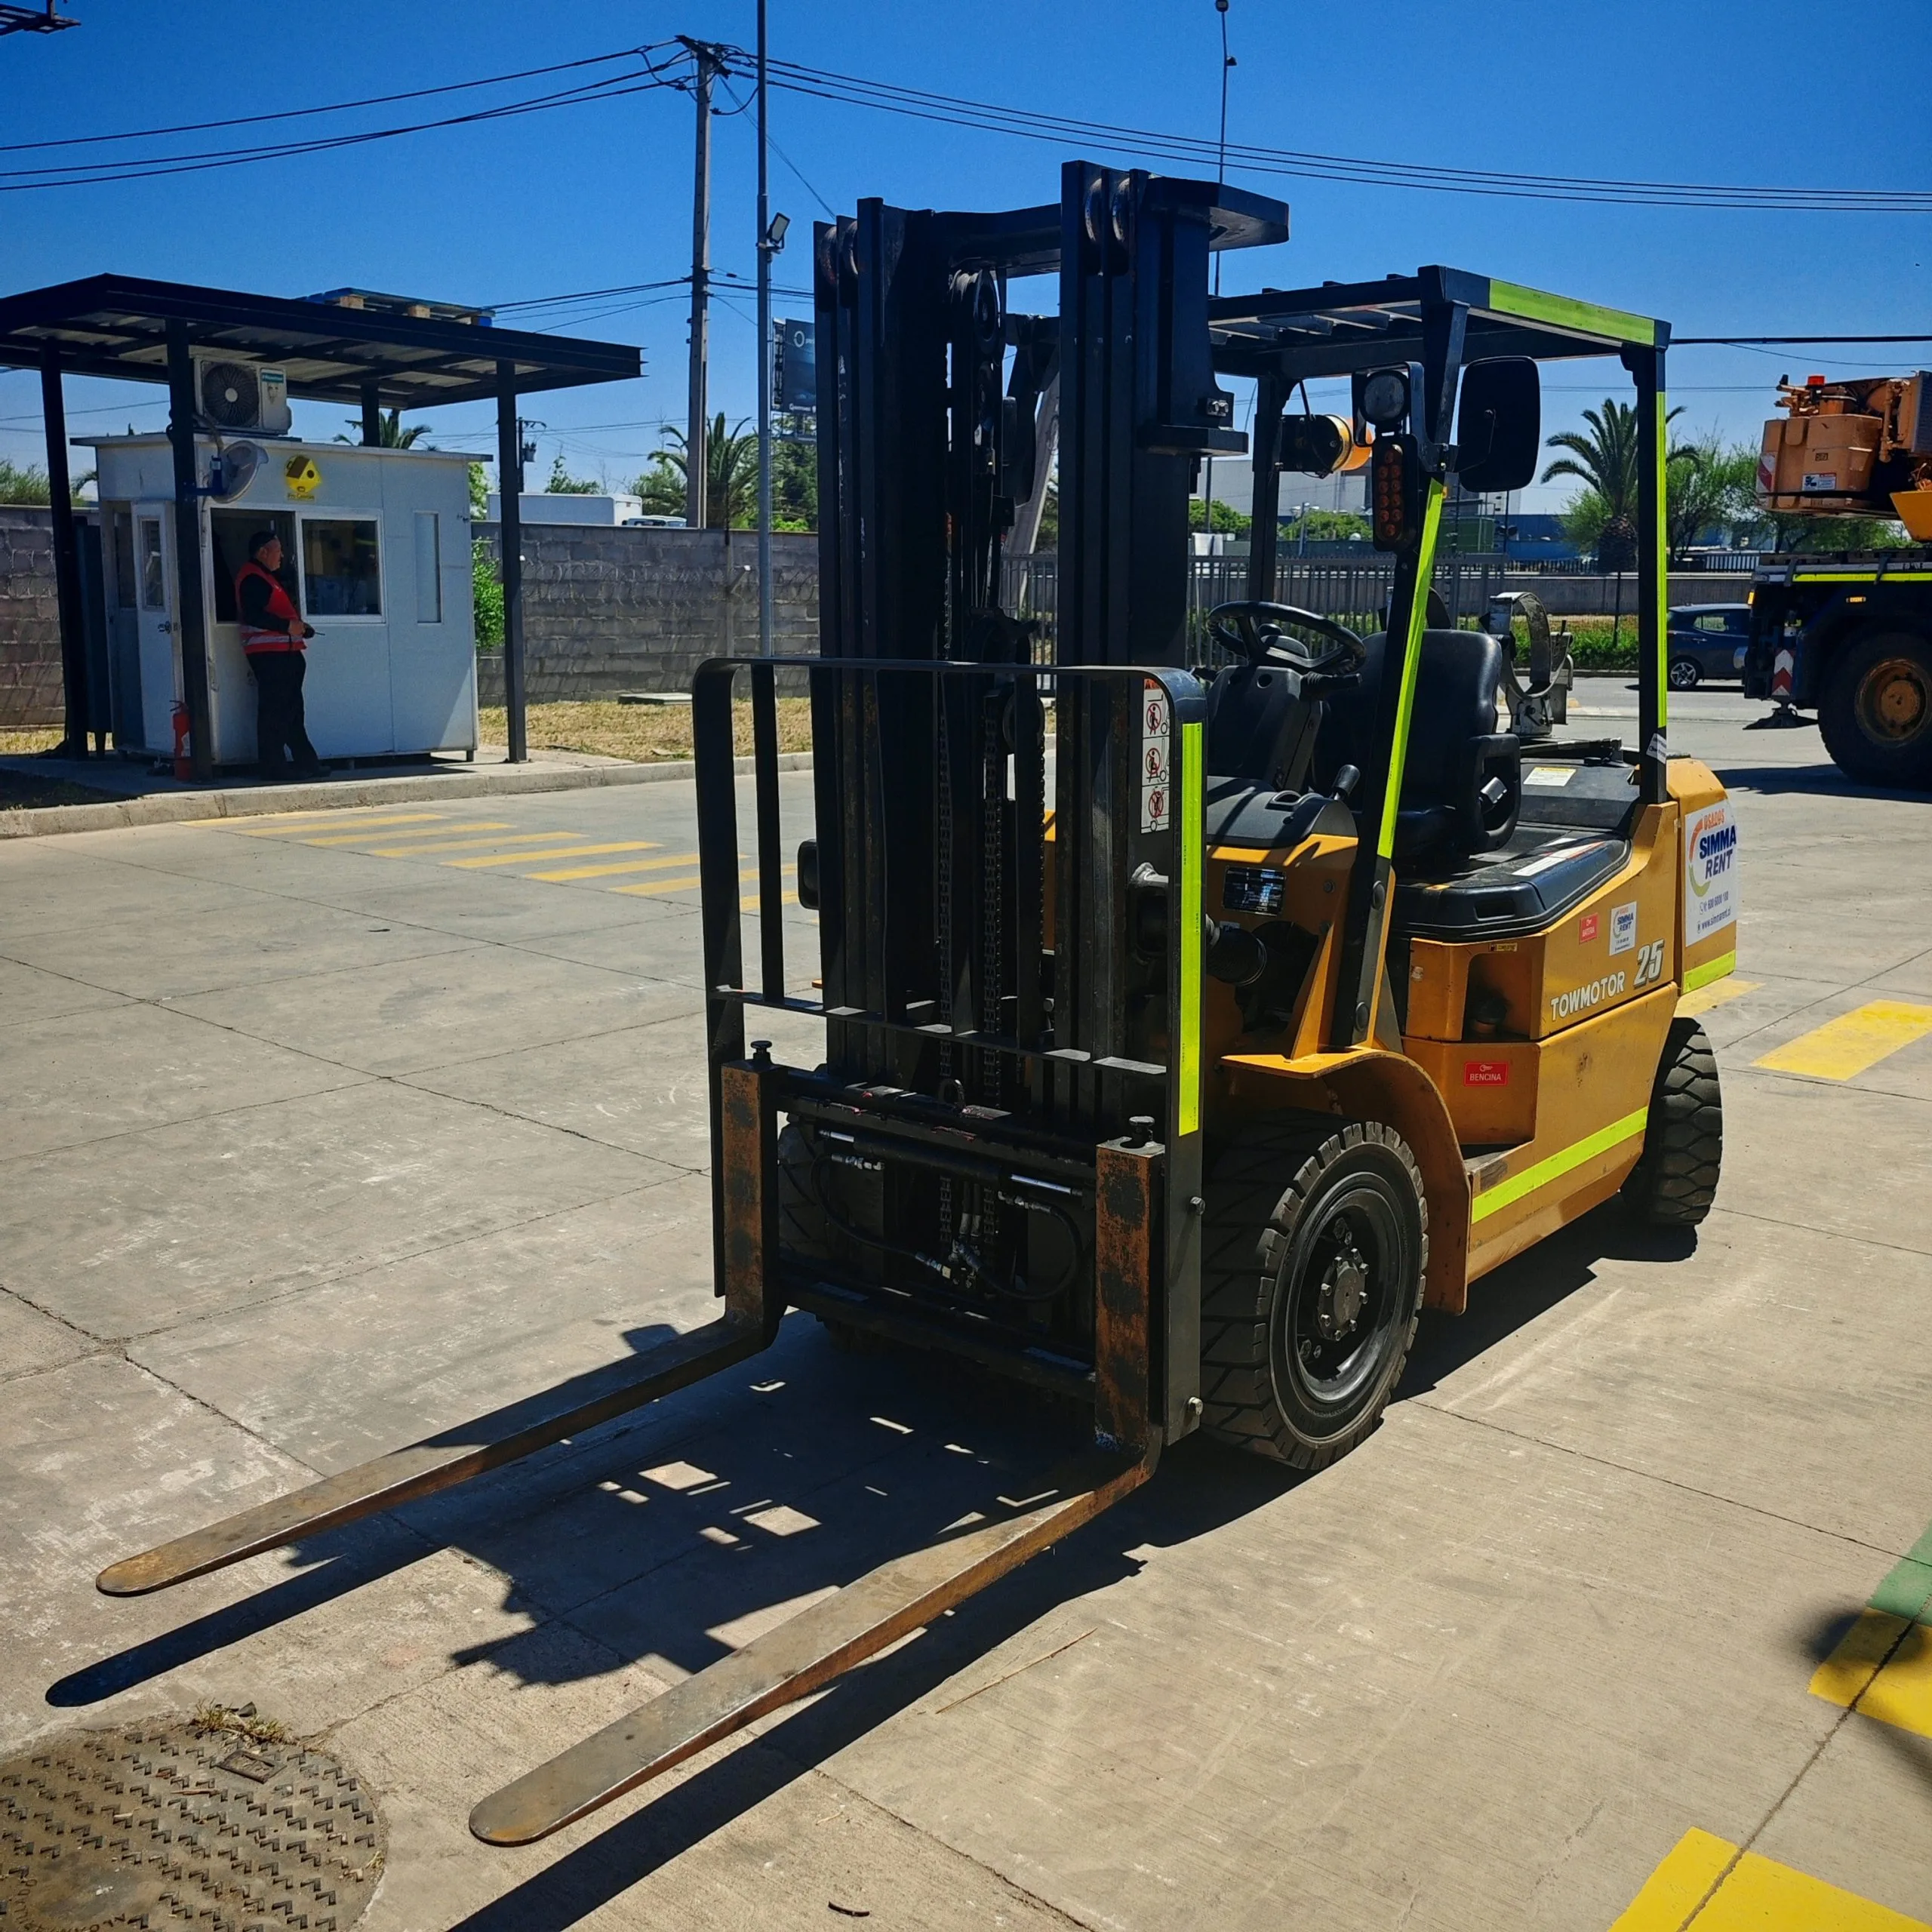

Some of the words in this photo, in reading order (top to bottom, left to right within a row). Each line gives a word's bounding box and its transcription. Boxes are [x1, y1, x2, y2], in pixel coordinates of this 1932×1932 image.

[1703, 809, 1724, 830] USADOS
[1700, 825, 1737, 860] SIMMA
[1705, 849, 1734, 879] RENT
[1617, 912, 1634, 925] SIMMA
[1619, 921, 1632, 932] RENT
[1633, 938, 1665, 989] 25
[1550, 971, 1626, 1021] TOWMOTOR
[1469, 1073, 1501, 1081] BENCINA
